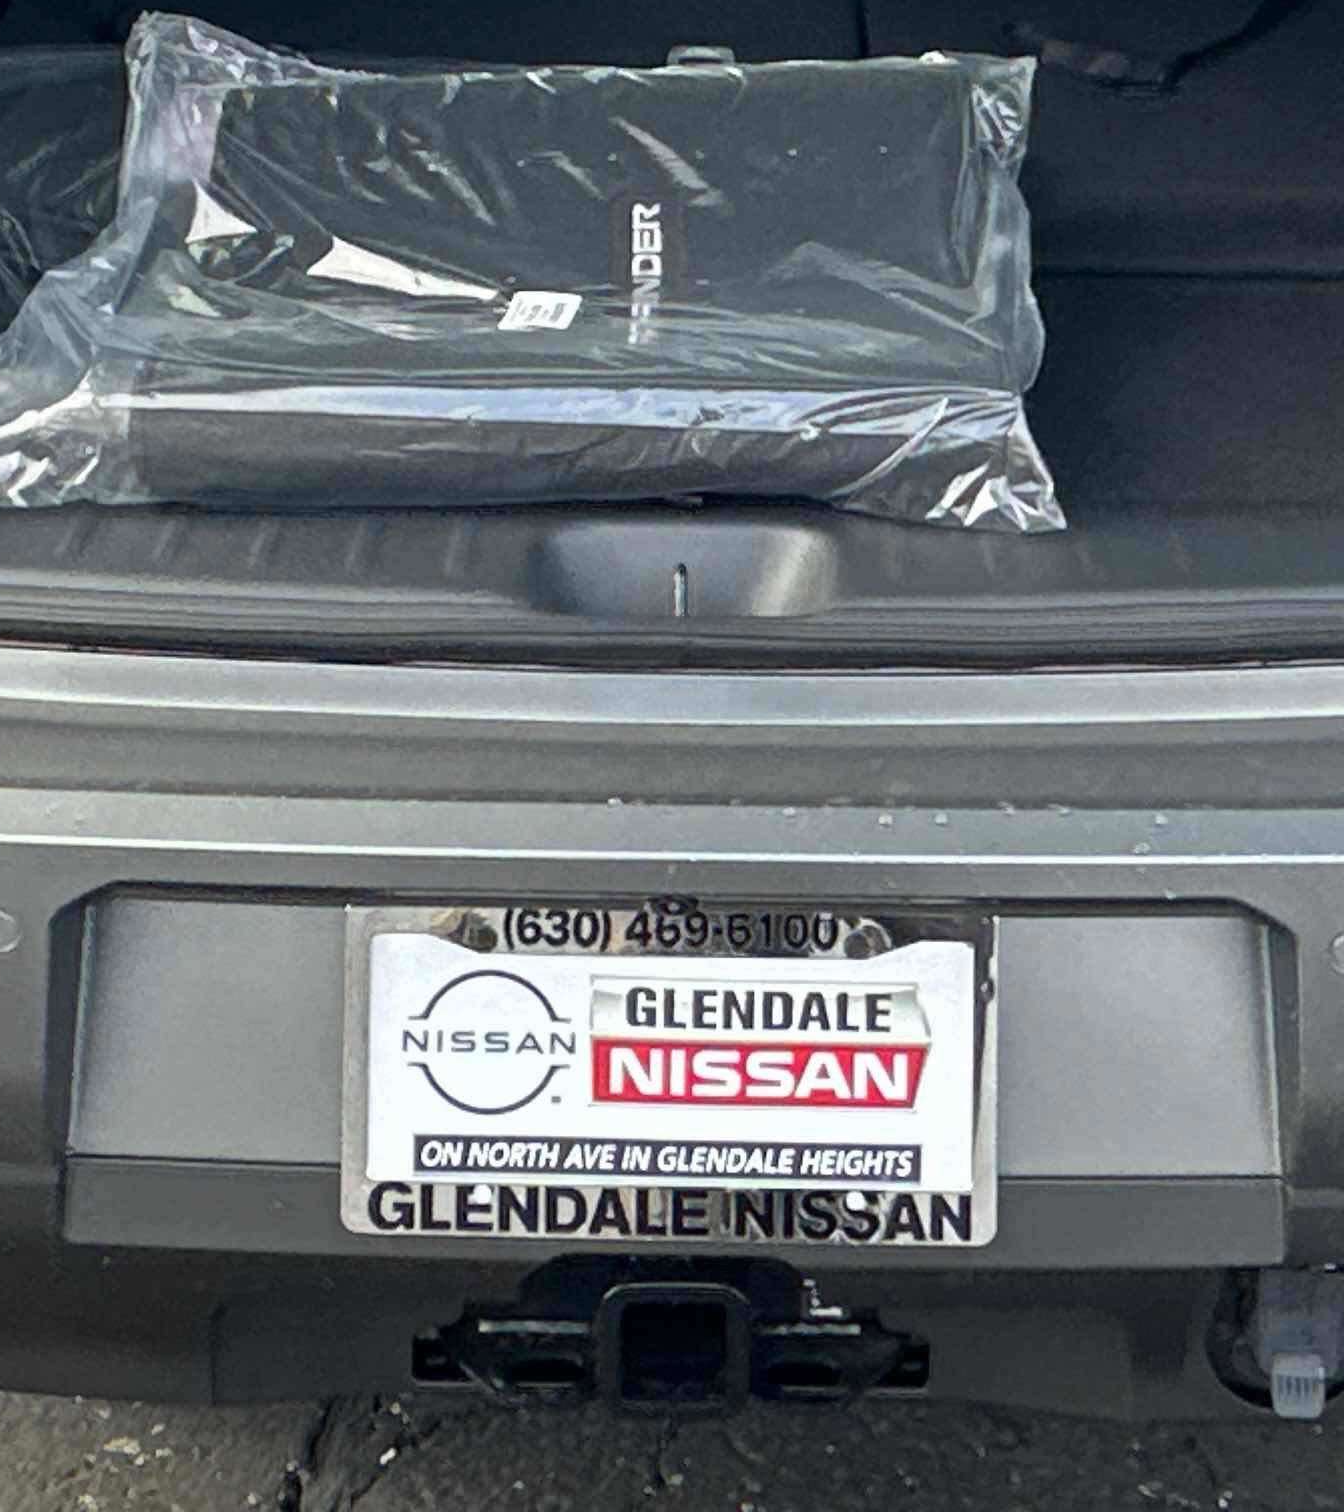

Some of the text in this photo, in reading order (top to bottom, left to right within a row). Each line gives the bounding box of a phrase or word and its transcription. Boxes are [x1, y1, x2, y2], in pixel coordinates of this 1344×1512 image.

[504, 908, 611, 952] (630)
[625, 986, 892, 1033] GLENDALE
[402, 1028, 577, 1056] NISSAN
[609, 1048, 908, 1101] NISSAN
[420, 1140, 914, 1178] ON NORTH AVE IN GLENDALE HEIGHTS
[368, 1182, 972, 1242] GLENDALE NISSAN
